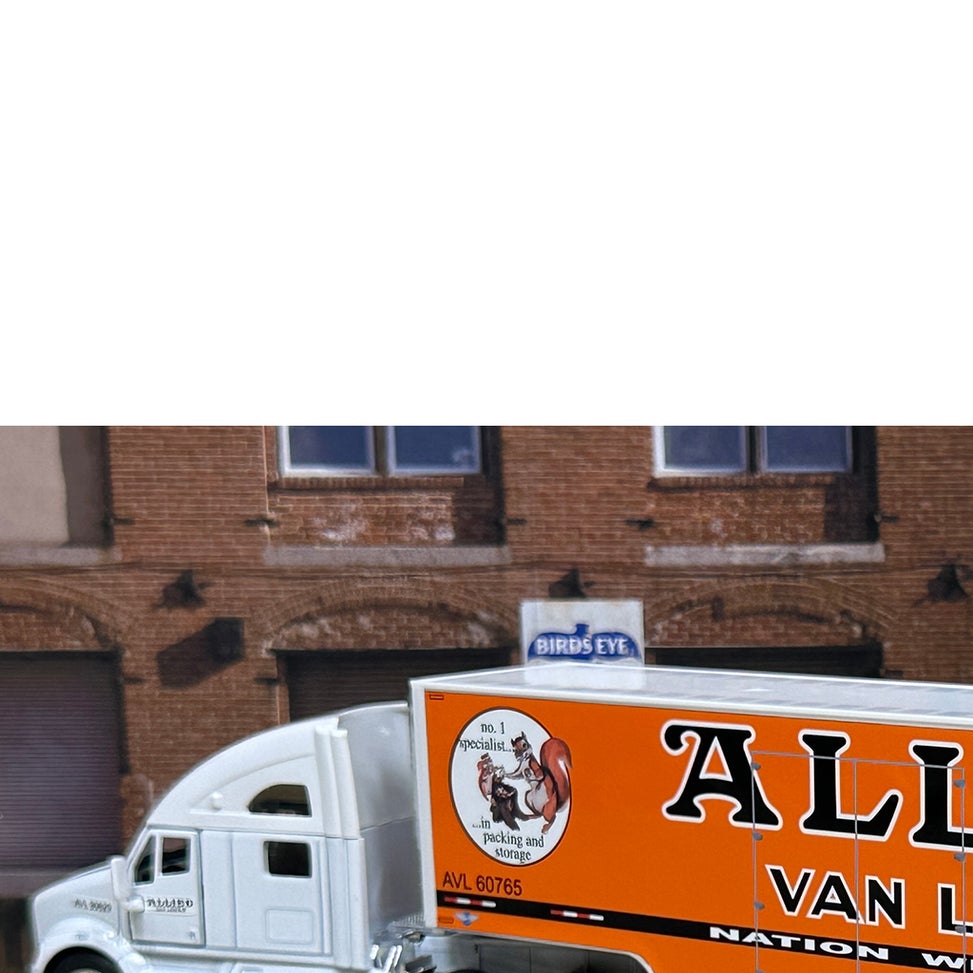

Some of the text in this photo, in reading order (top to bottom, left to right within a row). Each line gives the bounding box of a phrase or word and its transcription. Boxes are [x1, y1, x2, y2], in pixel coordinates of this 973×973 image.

[596, 637, 629, 655] EYE
[481, 721, 505, 735] no. 1
[483, 831, 545, 848] packing and
[495, 848, 532, 864] storage
[443, 871, 523, 896] AVL 60765
[765, 864, 906, 929] VAN
[709, 926, 889, 961] NATION
